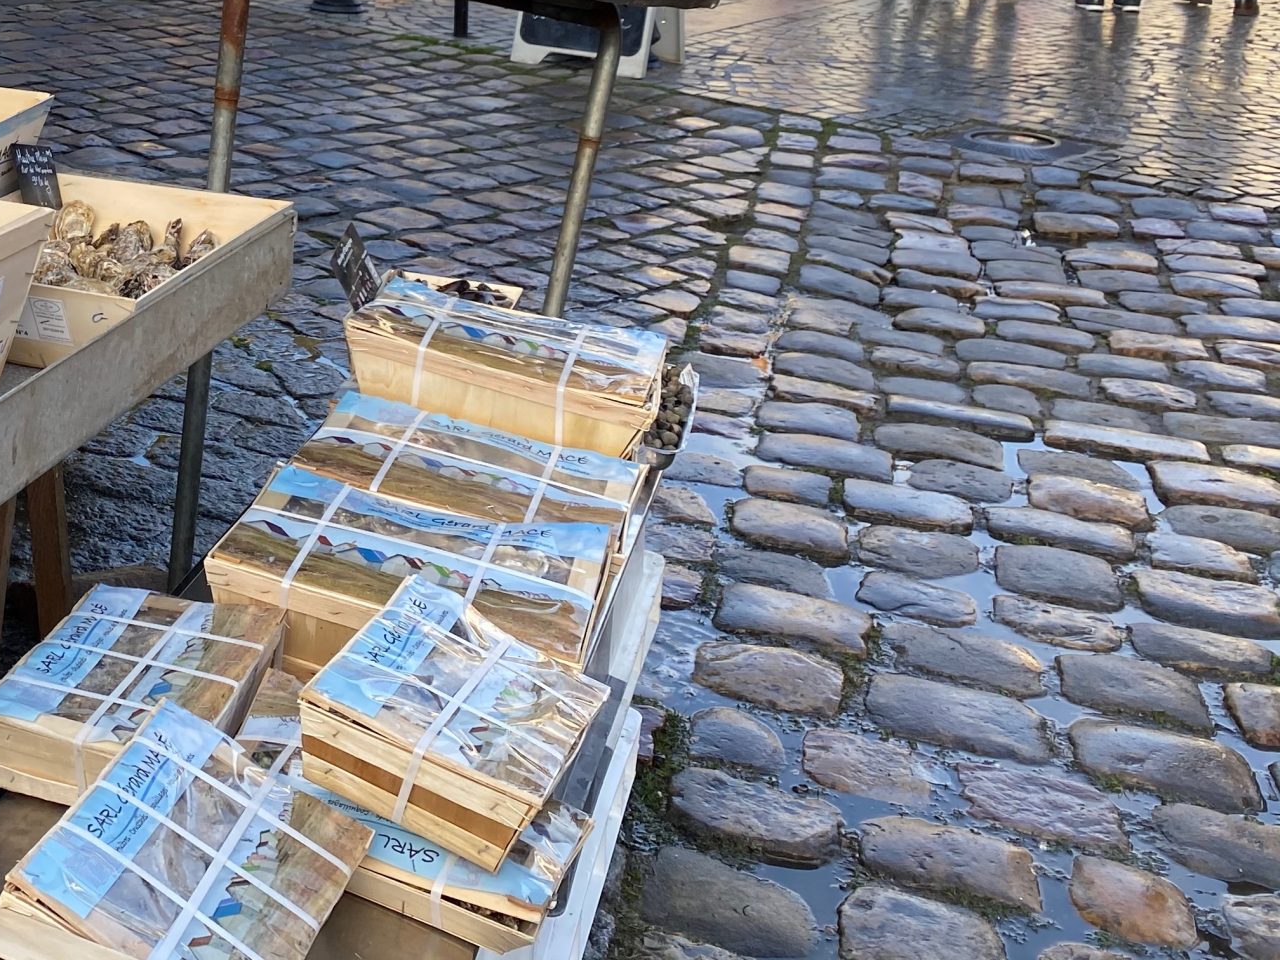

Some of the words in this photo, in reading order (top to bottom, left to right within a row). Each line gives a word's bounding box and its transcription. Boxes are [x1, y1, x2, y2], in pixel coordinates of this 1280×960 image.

[36, 651, 66, 674] SARL
[87, 803, 122, 839] SARL
[377, 832, 440, 864] SARL
